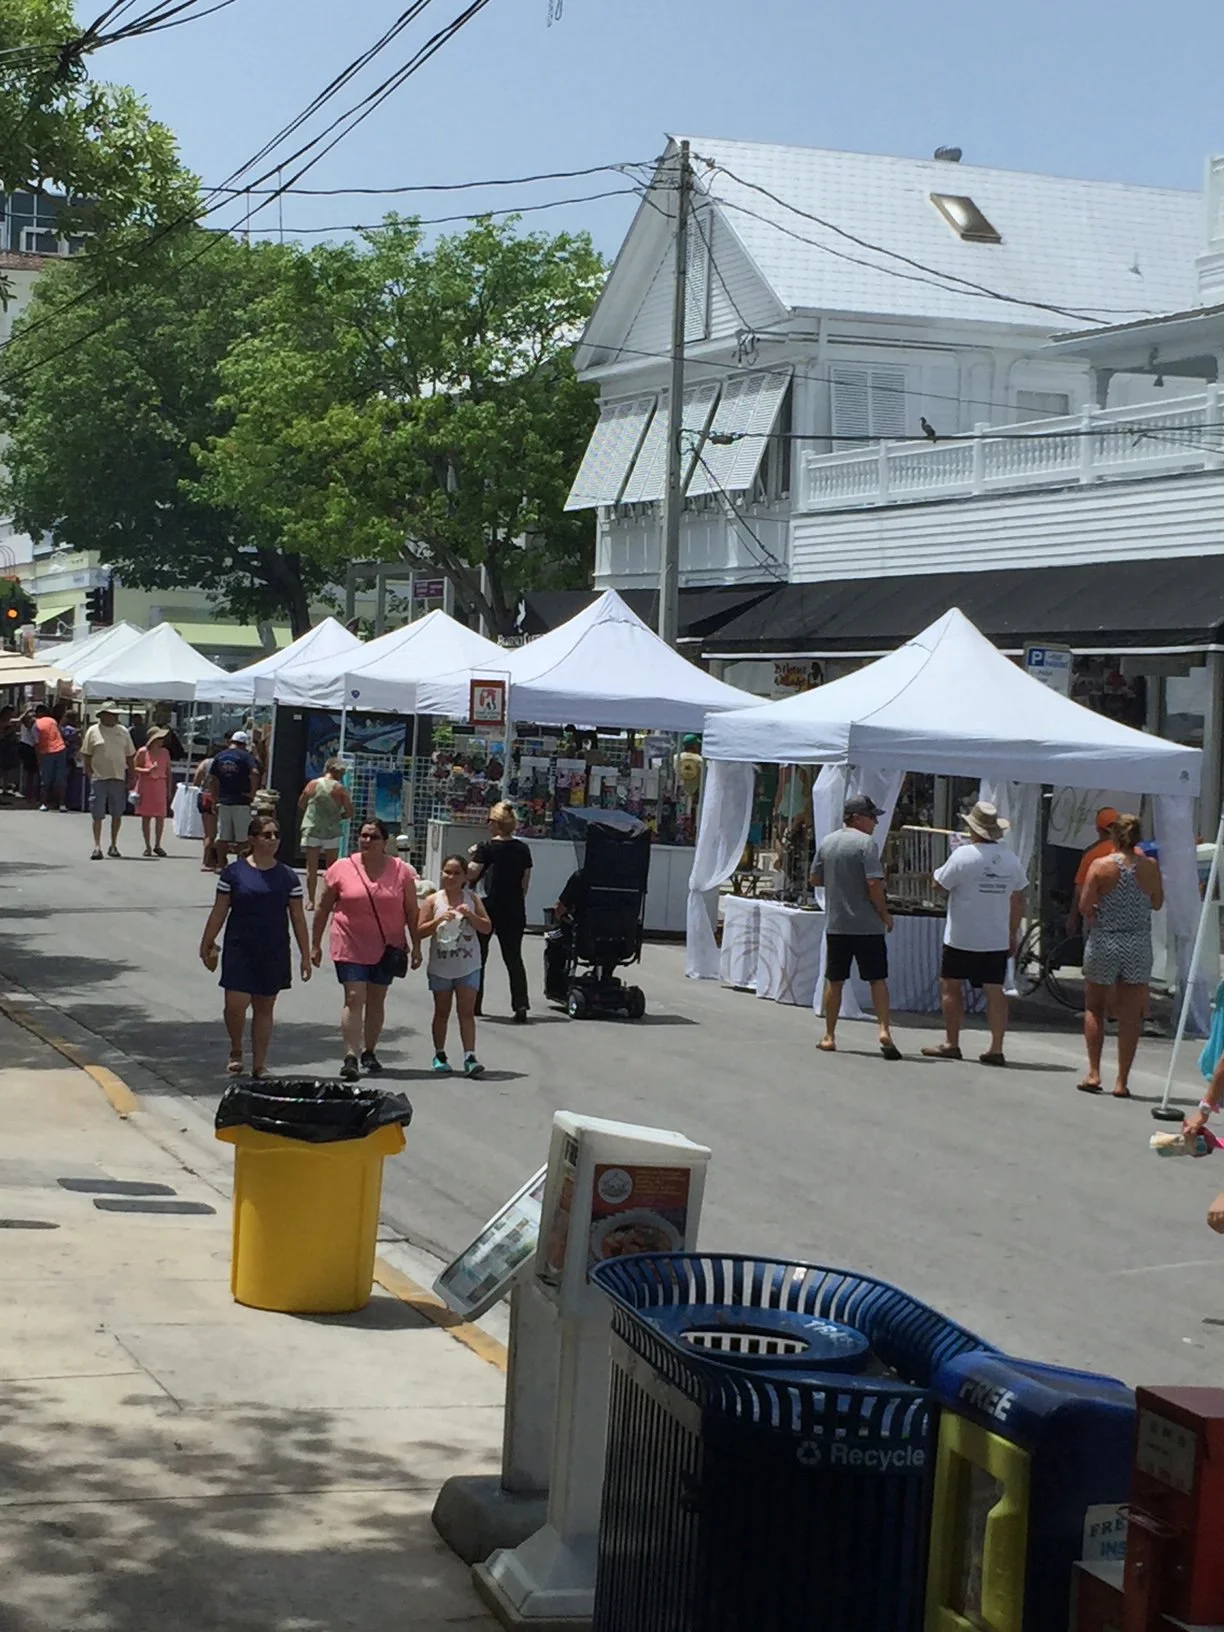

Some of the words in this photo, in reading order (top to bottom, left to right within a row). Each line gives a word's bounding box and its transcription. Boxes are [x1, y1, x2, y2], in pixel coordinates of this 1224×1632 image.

[1031, 650, 1043, 664] P
[958, 1381, 1016, 1421] FREE
[829, 1442, 926, 1471] Recycle
